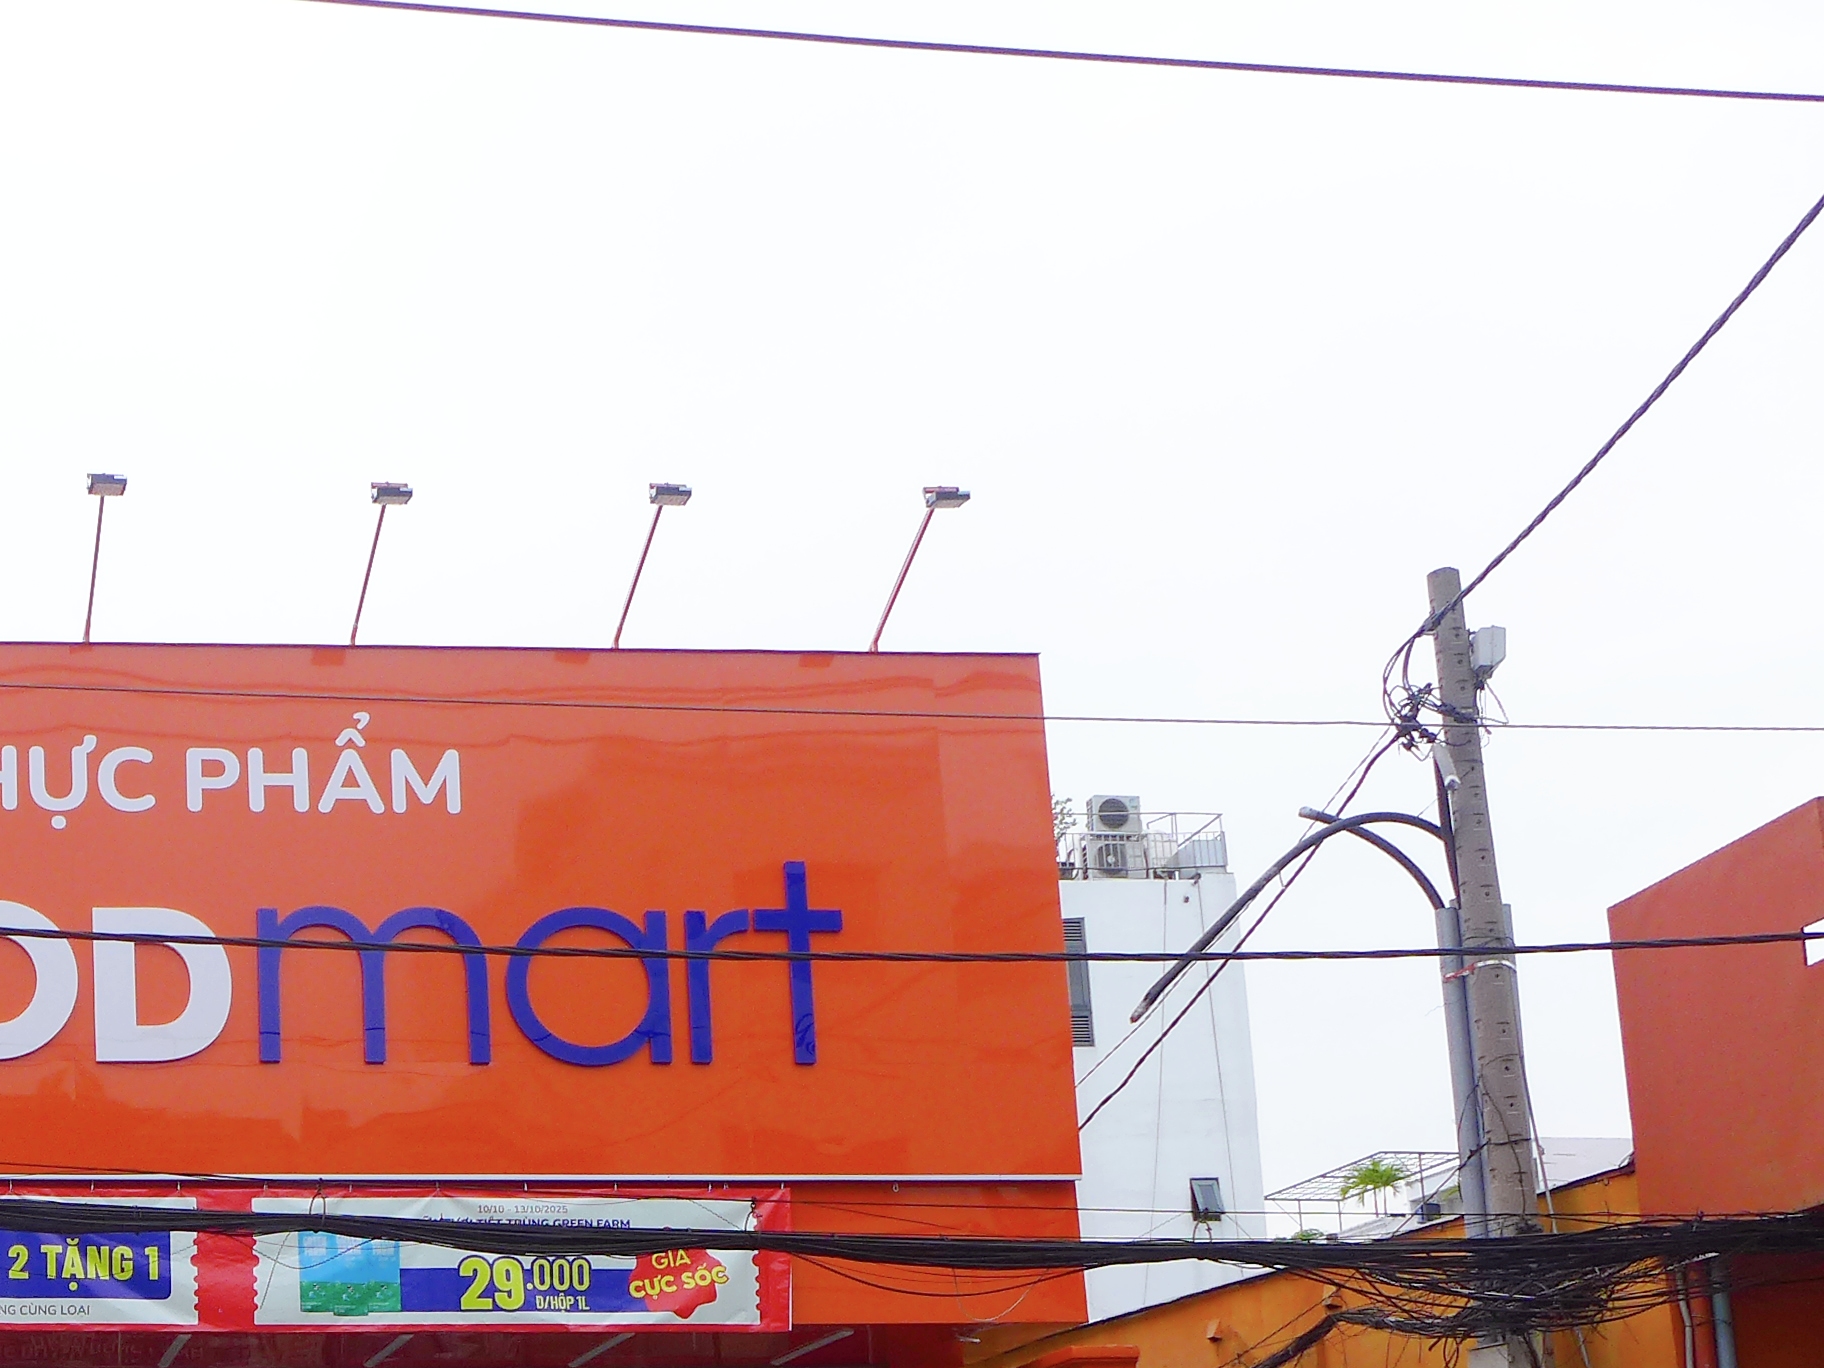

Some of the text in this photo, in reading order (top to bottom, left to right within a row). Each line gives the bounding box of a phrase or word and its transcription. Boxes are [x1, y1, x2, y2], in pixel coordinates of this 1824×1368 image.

[186, 711, 464, 814] PHẨM
[477, 1204, 569, 1215] 10/10 13/10/2025
[7, 1243, 30, 1280] 2
[41, 1238, 134, 1292] TẶNG
[143, 1244, 160, 1281] 1
[629, 1262, 728, 1301] CỰC SỐC
[19, 1301, 58, 1317] CÙNG
[59, 1302, 91, 1319] LOẠI
